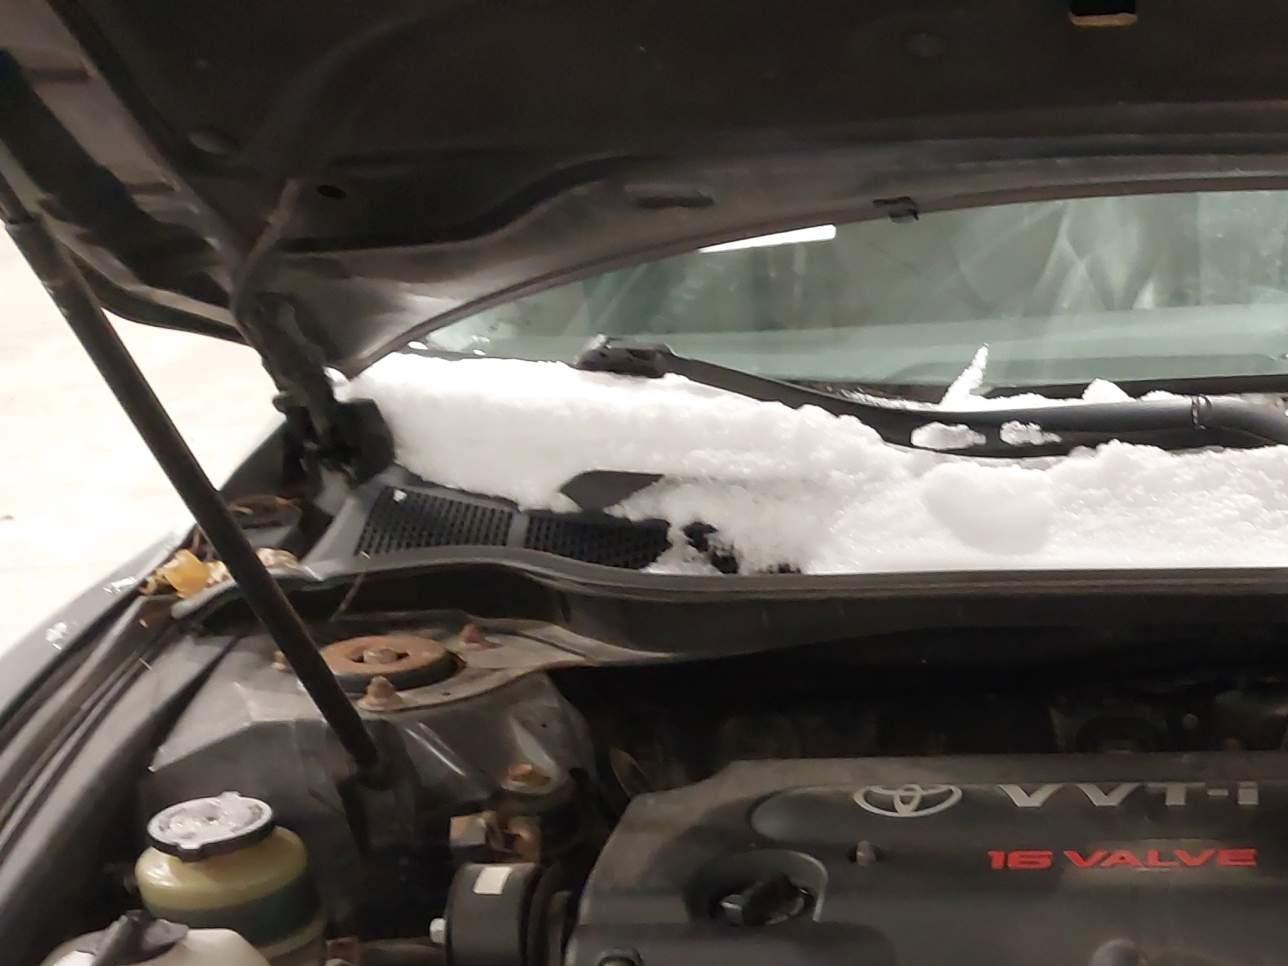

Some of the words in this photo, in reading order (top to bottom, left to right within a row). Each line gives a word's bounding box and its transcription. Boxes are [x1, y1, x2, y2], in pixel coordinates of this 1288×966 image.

[999, 782, 1258, 807] VVT-i
[987, 850, 1053, 869] 16
[1064, 849, 1257, 869] VALVE
